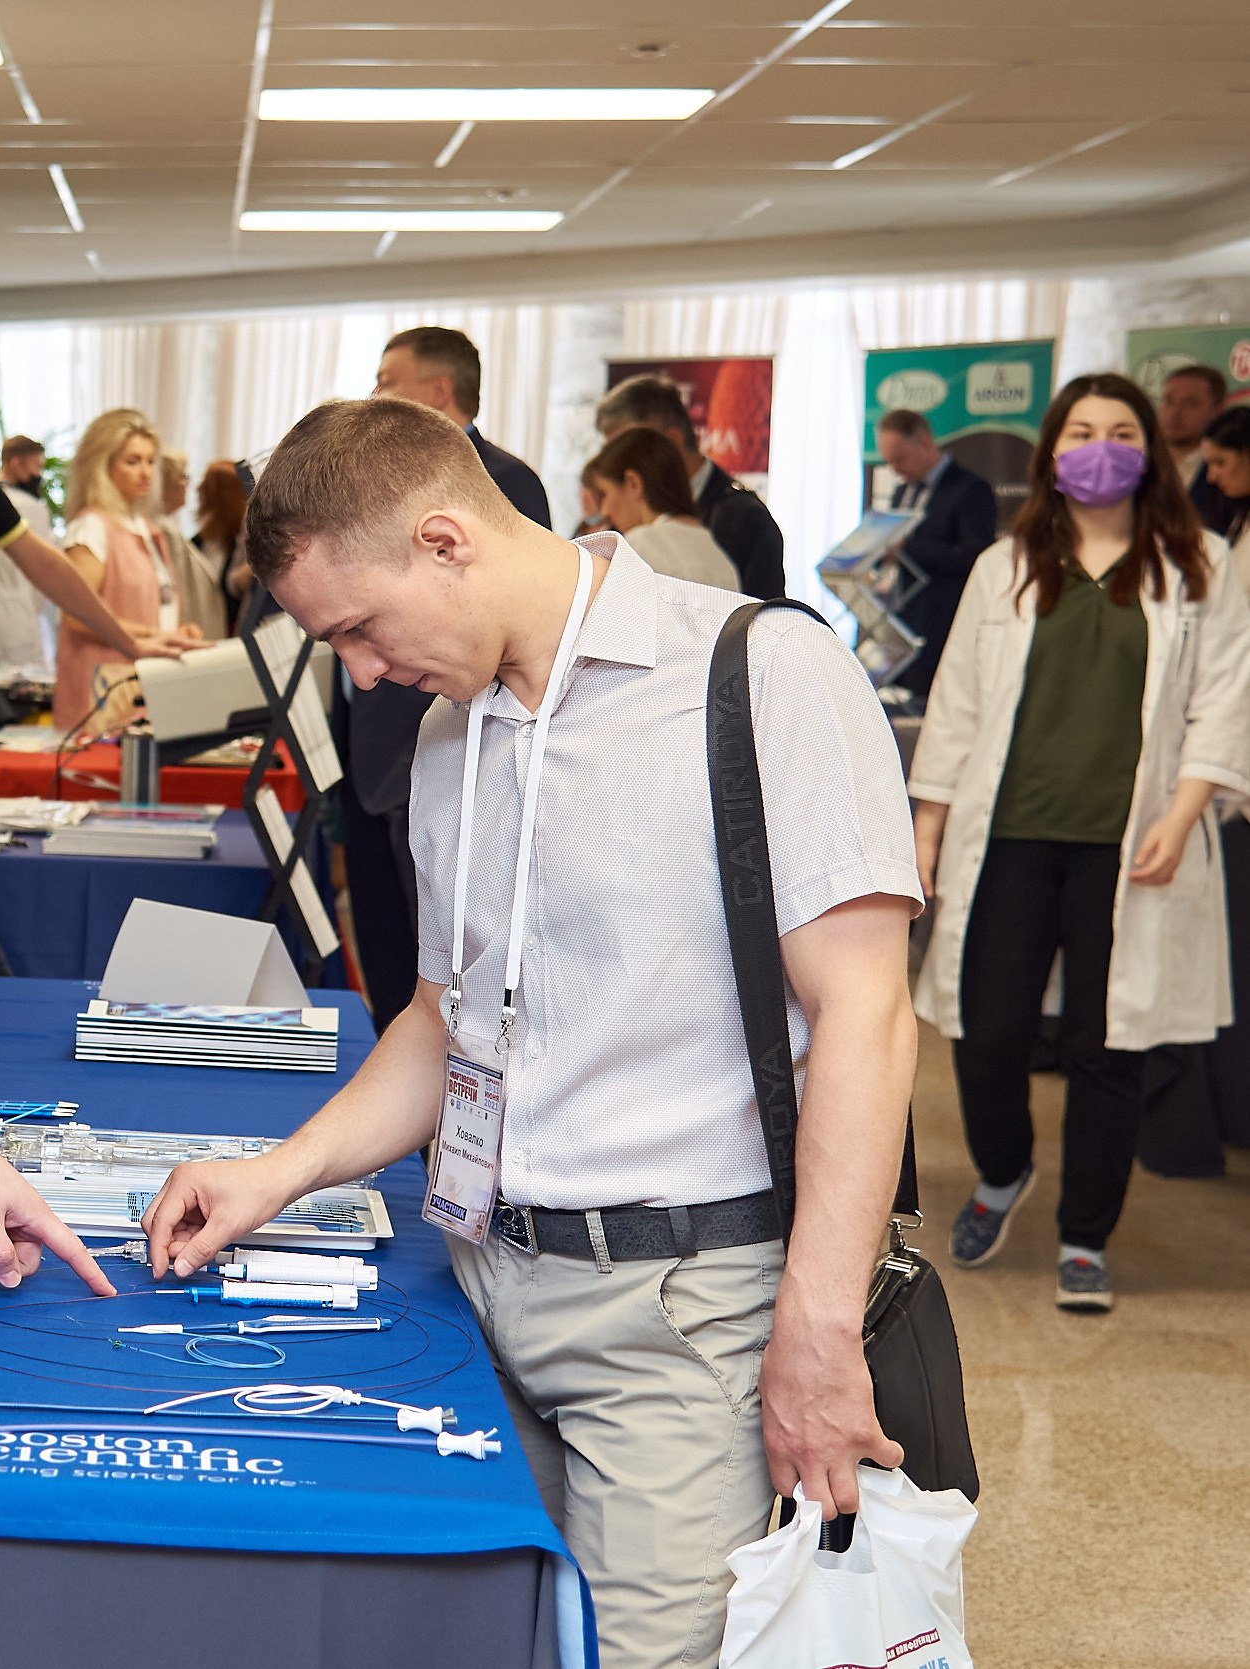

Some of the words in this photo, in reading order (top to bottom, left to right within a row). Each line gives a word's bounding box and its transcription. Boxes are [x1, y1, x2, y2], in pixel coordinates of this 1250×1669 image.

[448, 1079, 478, 1103] ВСТРЕЧИ
[483, 1098, 499, 1111] 2021
[455, 1124, 484, 1148] Ховалко
[441, 1139, 462, 1157] Михаил
[461, 1148, 495, 1171] Михайлович
[431, 1195, 466, 1220] УЧАСТНИК
[71, 1468, 185, 1482] science
[198, 1474, 240, 1484] for
